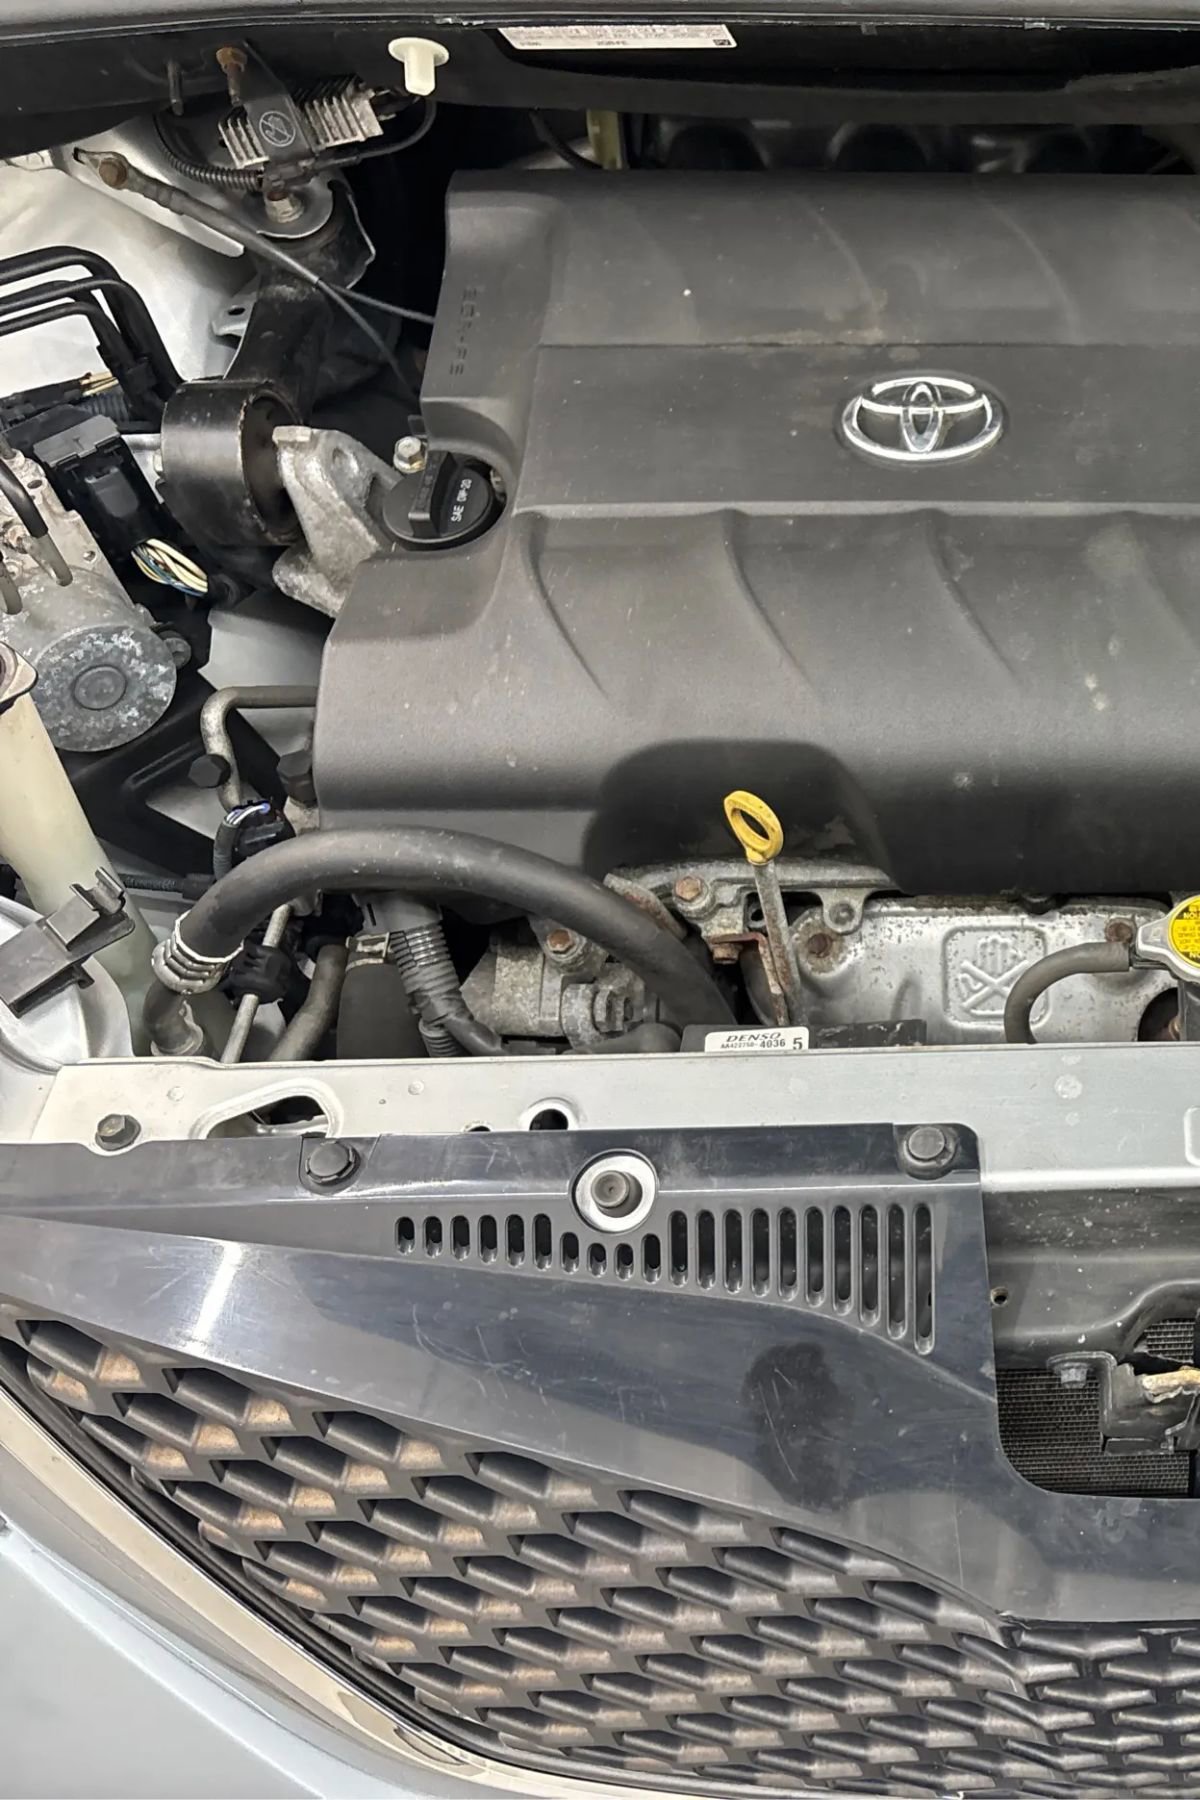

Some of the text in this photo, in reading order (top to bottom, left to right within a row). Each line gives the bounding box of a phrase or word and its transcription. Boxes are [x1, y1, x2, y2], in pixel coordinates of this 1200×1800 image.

[450, 478, 473, 523] SAE 0W-20
[725, 1032, 782, 1042] DENSO
[792, 1036, 804, 1051] 5
